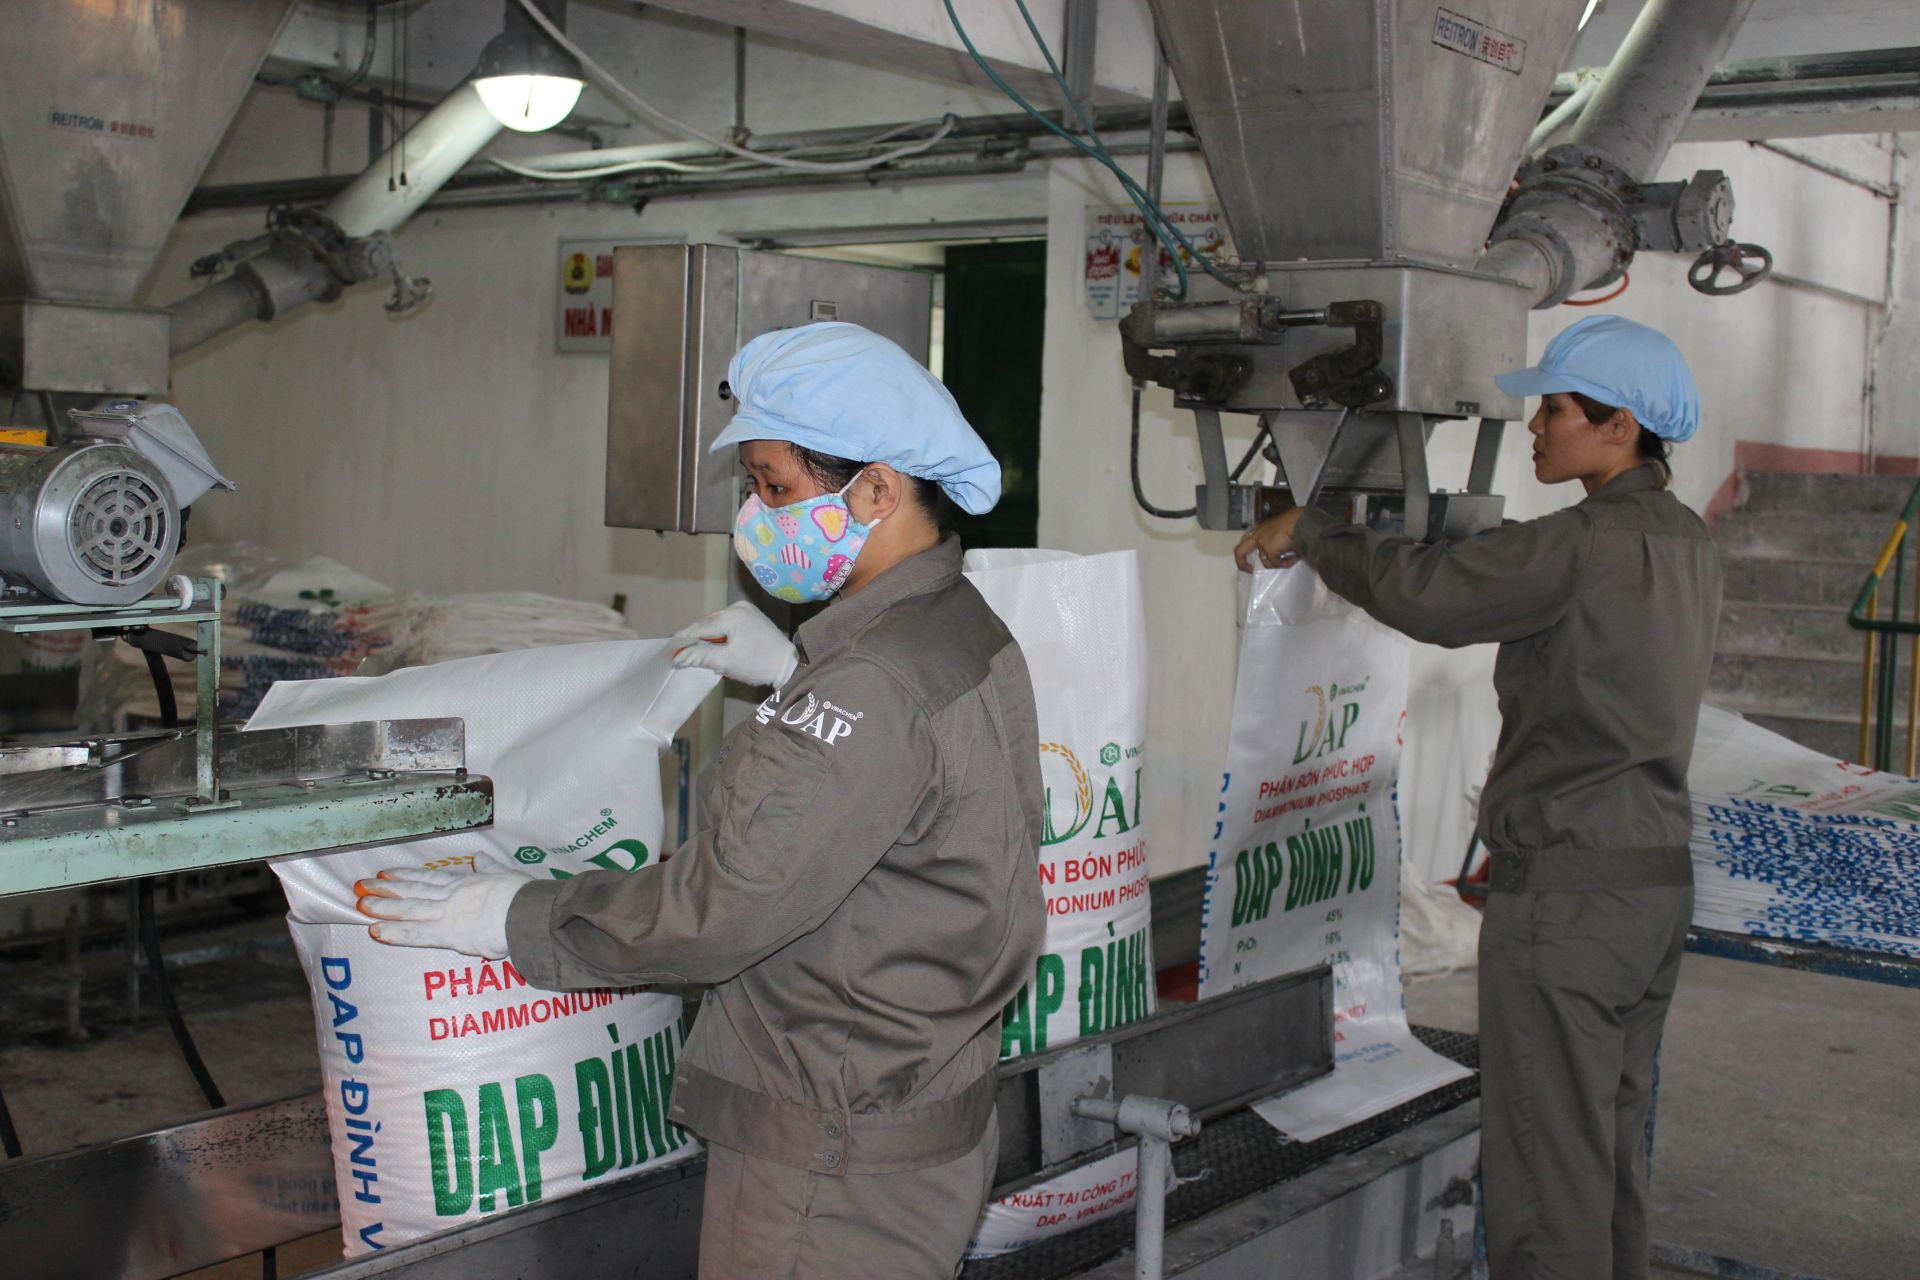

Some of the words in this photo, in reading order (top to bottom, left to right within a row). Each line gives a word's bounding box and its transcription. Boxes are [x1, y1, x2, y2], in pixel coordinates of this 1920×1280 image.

[1065, 851, 1112, 883] BÓN
[1231, 842, 1284, 928] DAP
[321, 956, 364, 1065] DAP
[429, 986, 613, 1041] DIAMMONIUM
[341, 1077, 382, 1204] ĐÌNH
[423, 1073, 559, 1217] DAP
[1035, 1212, 1067, 1228] DAP
[1081, 1179, 1117, 1202] CÔNG
